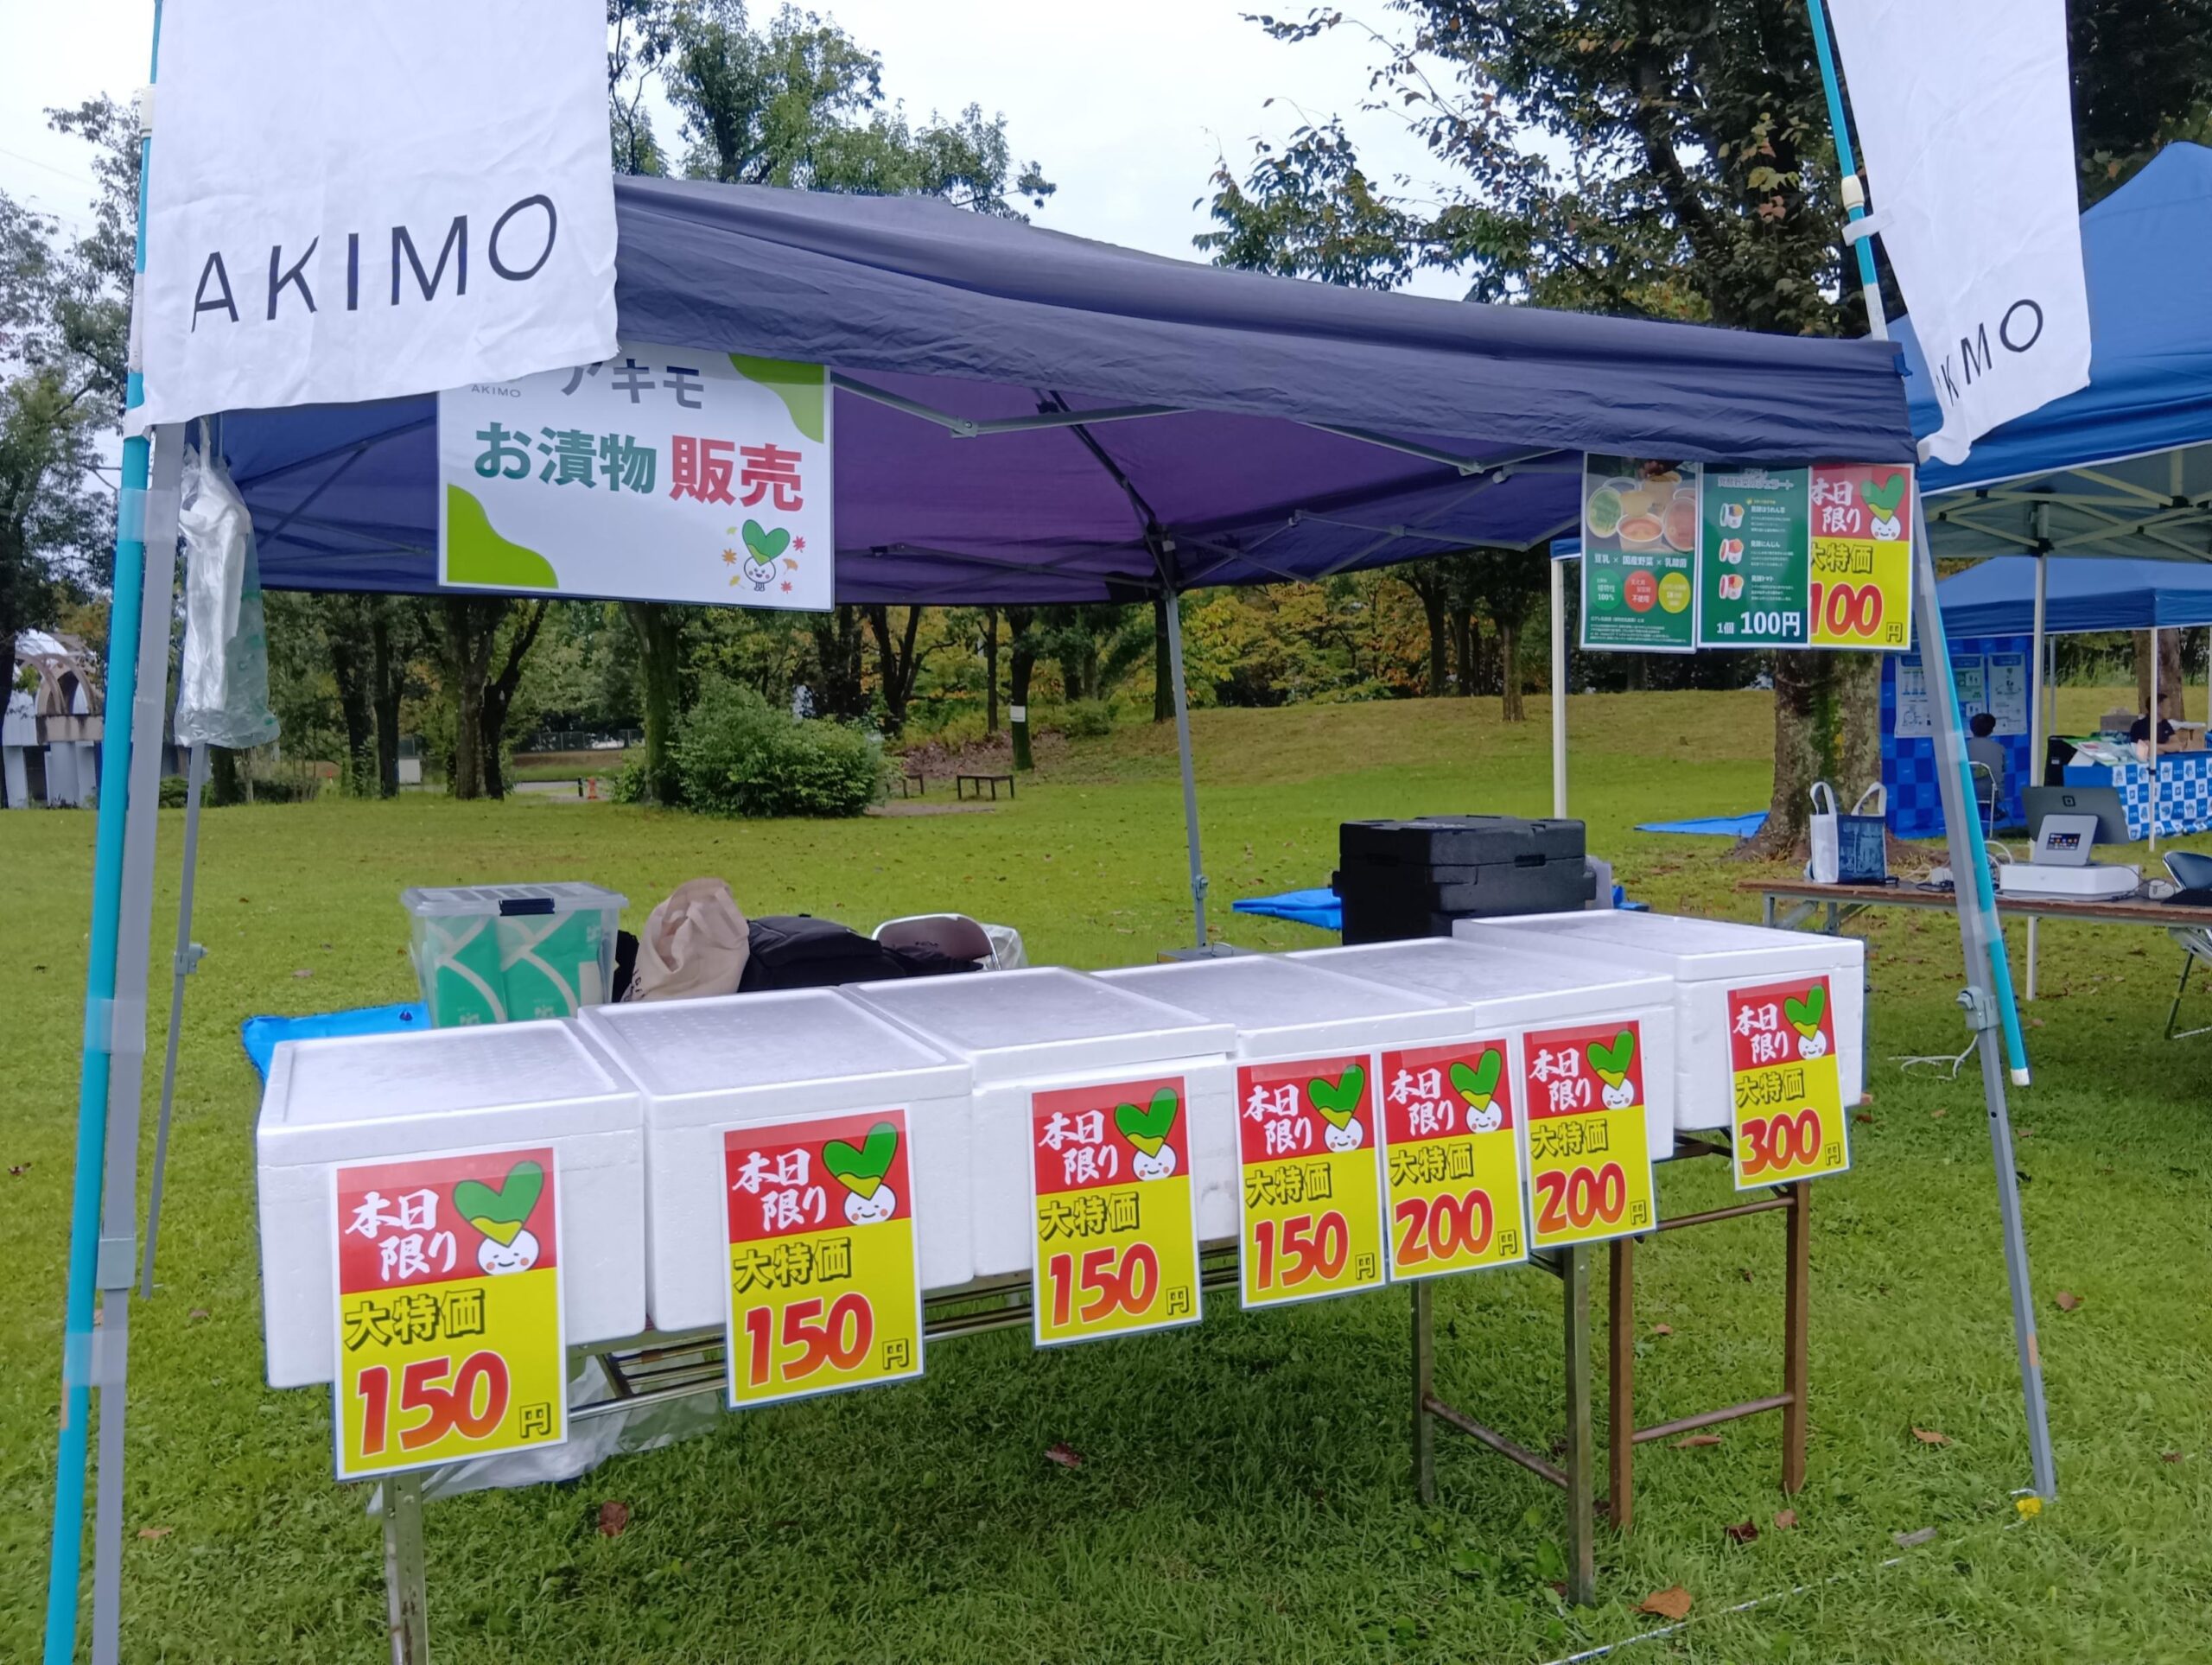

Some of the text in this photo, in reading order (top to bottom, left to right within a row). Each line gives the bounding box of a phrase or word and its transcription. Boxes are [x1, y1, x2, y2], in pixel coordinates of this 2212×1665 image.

[191, 194, 557, 334] AKIMO
[471, 384, 521, 397] AKIMO
[1811, 478, 1853, 506] 本日
[1822, 505, 1860, 533] 限り
[1811, 542, 1872, 574] 大特価
[1740, 612, 1800, 637] 100円
[1733, 1002, 1778, 1035] 本日
[1529, 1047, 1580, 1082] 本日
[1750, 1031, 1789, 1064] 限り
[1243, 1084, 1300, 1122] 本日
[1387, 1068, 1441, 1104] 本日
[1548, 1077, 1591, 1113] 限り
[1735, 1068, 1805, 1108] 大特価
[1038, 1109, 1105, 1151] 本日
[1264, 1116, 1312, 1155] 限り
[1408, 1099, 1454, 1137] 限り
[1530, 1118, 1608, 1160] 大特価
[733, 1148, 810, 1194] 本日
[1062, 1144, 1118, 1185] 限り
[1389, 1142, 1474, 1186] 大特価
[1245, 1162, 1332, 1209] 大特価
[345, 1188, 439, 1238] 本日
[760, 1185, 827, 1232] 限り
[1039, 1192, 1140, 1242] 大特価
[378, 1230, 456, 1281] 限り
[734, 1236, 851, 1293] 大特価
[344, 1287, 485, 1351] 大特価
